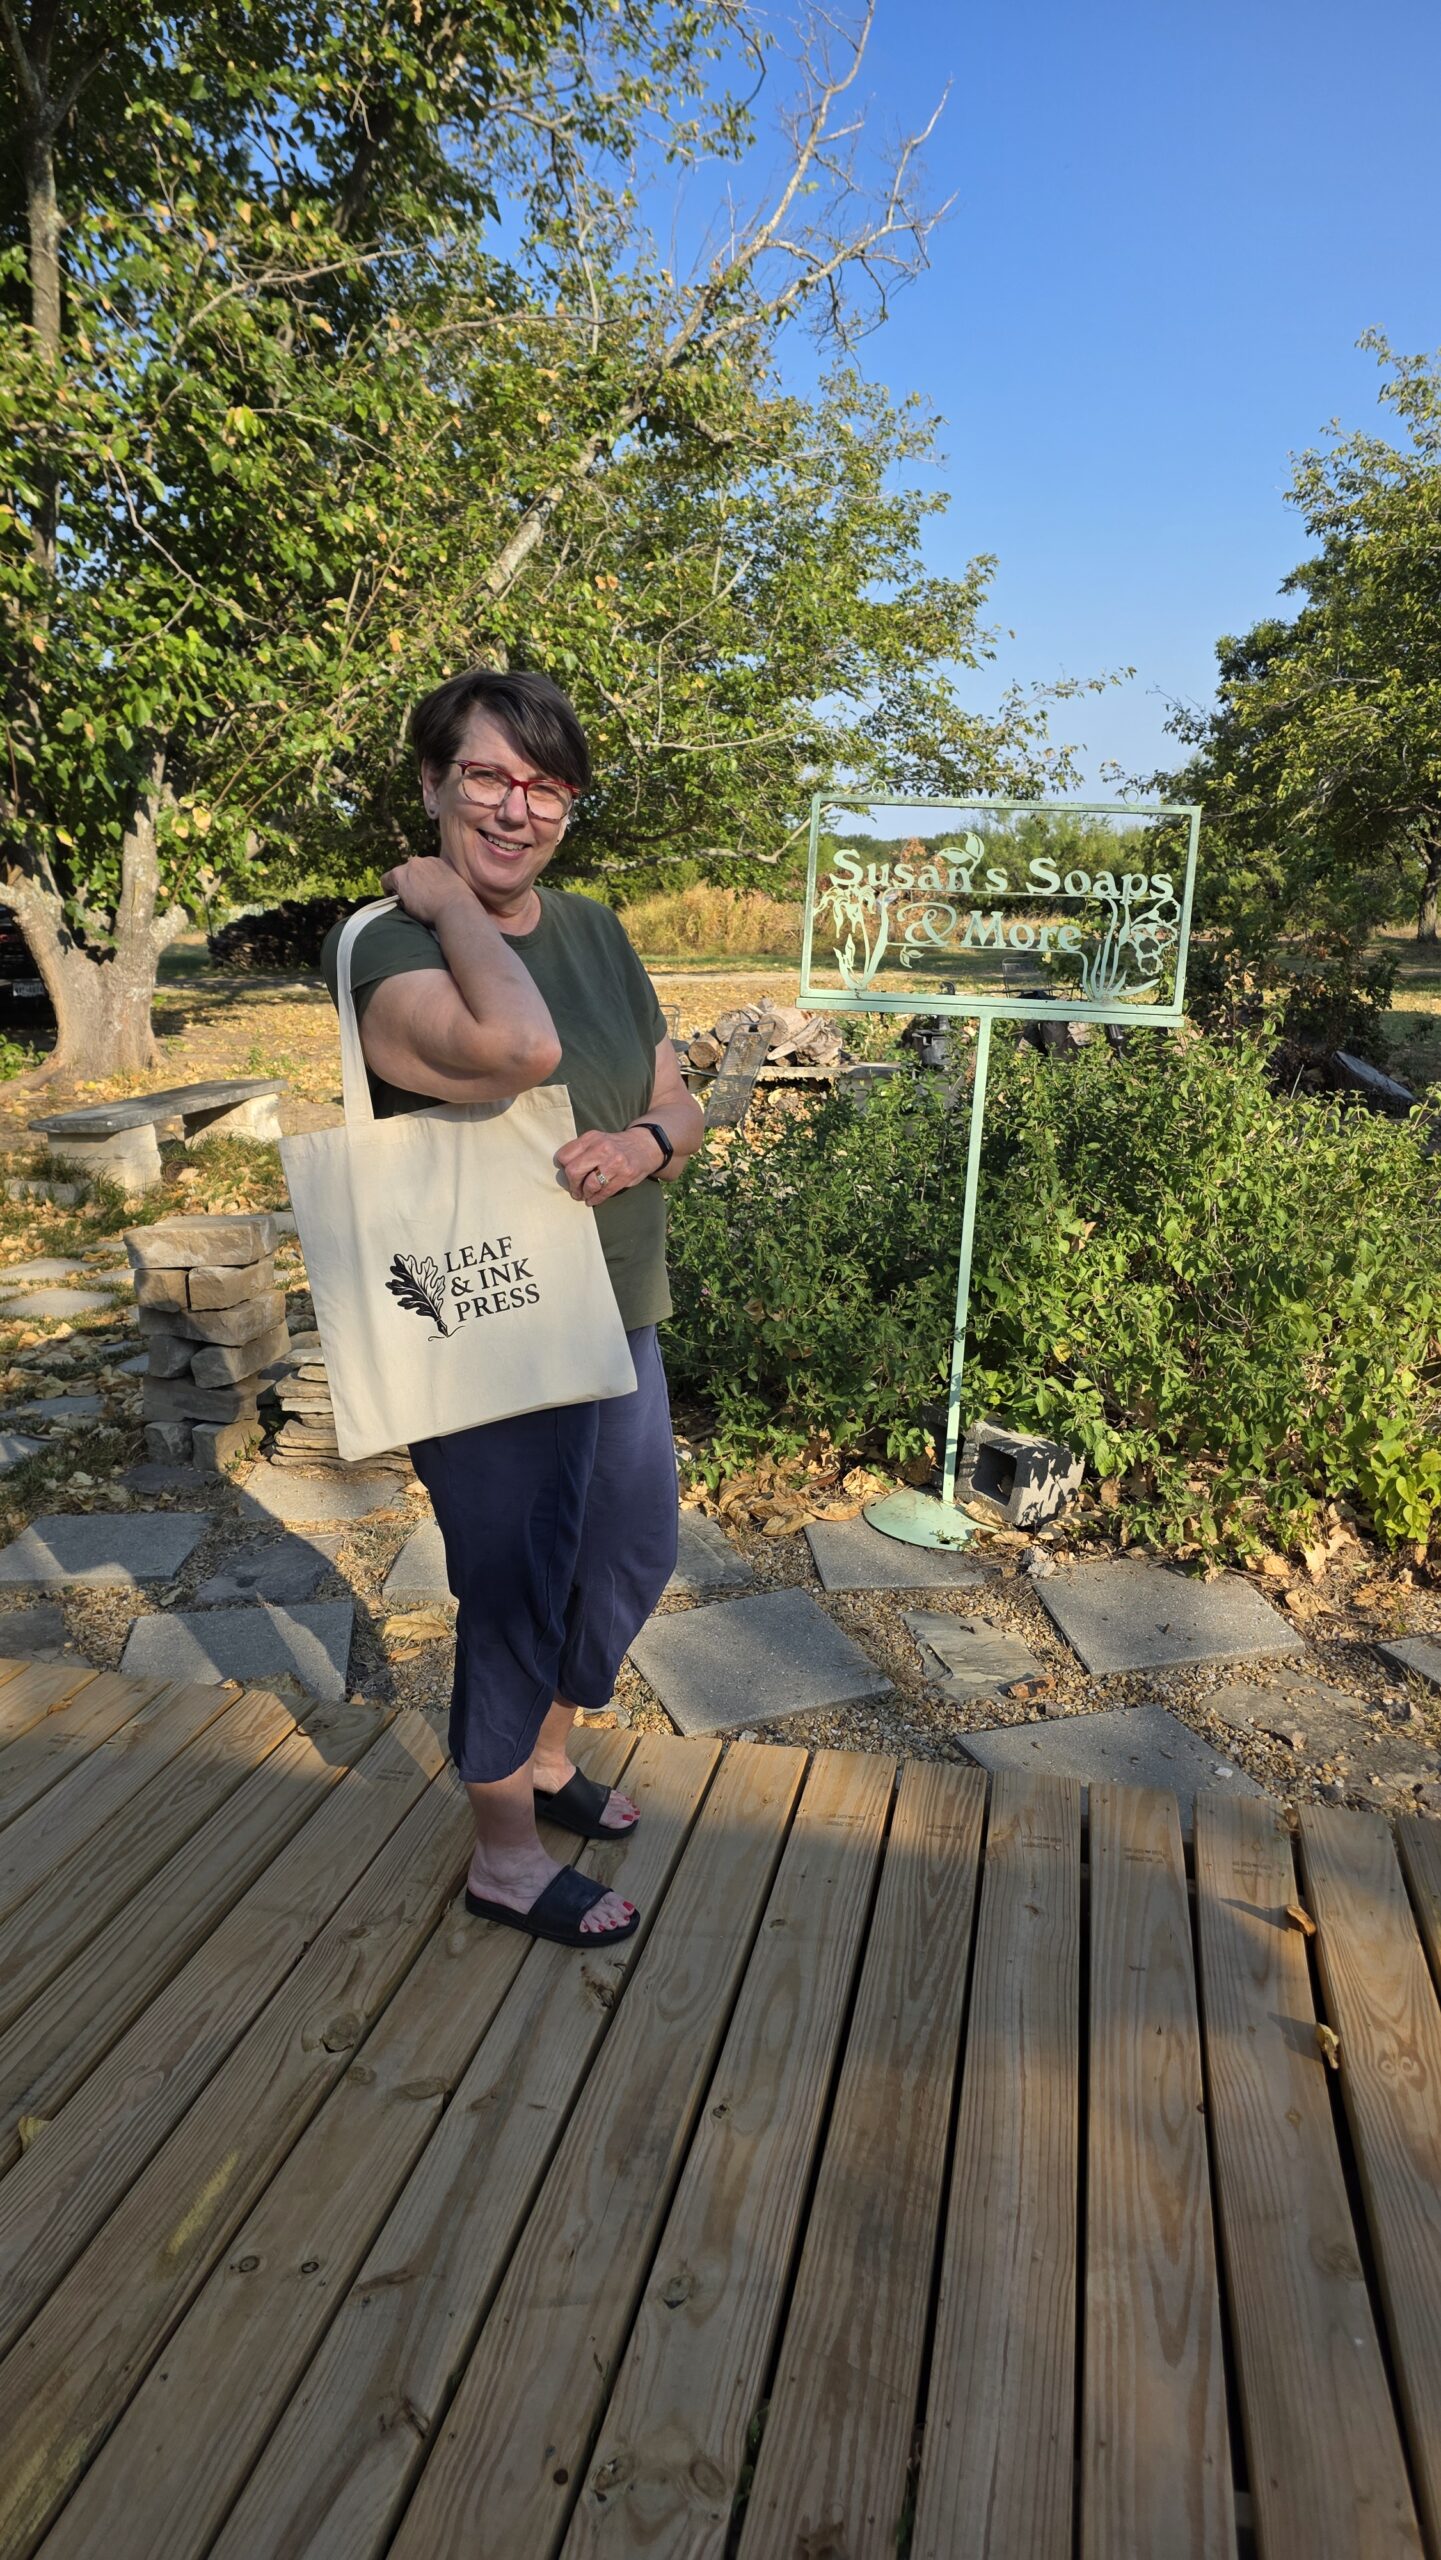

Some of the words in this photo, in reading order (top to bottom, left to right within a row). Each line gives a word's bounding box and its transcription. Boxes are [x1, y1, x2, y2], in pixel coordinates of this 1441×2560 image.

[1026, 857, 1174, 902] Soaps
[897, 902, 957, 947] &
[962, 910, 1082, 951] More
[444, 1236, 512, 1273] LEAF
[450, 1276, 474, 1297] &
[477, 1258, 534, 1290] INK
[454, 1284, 540, 1323] PRESS
